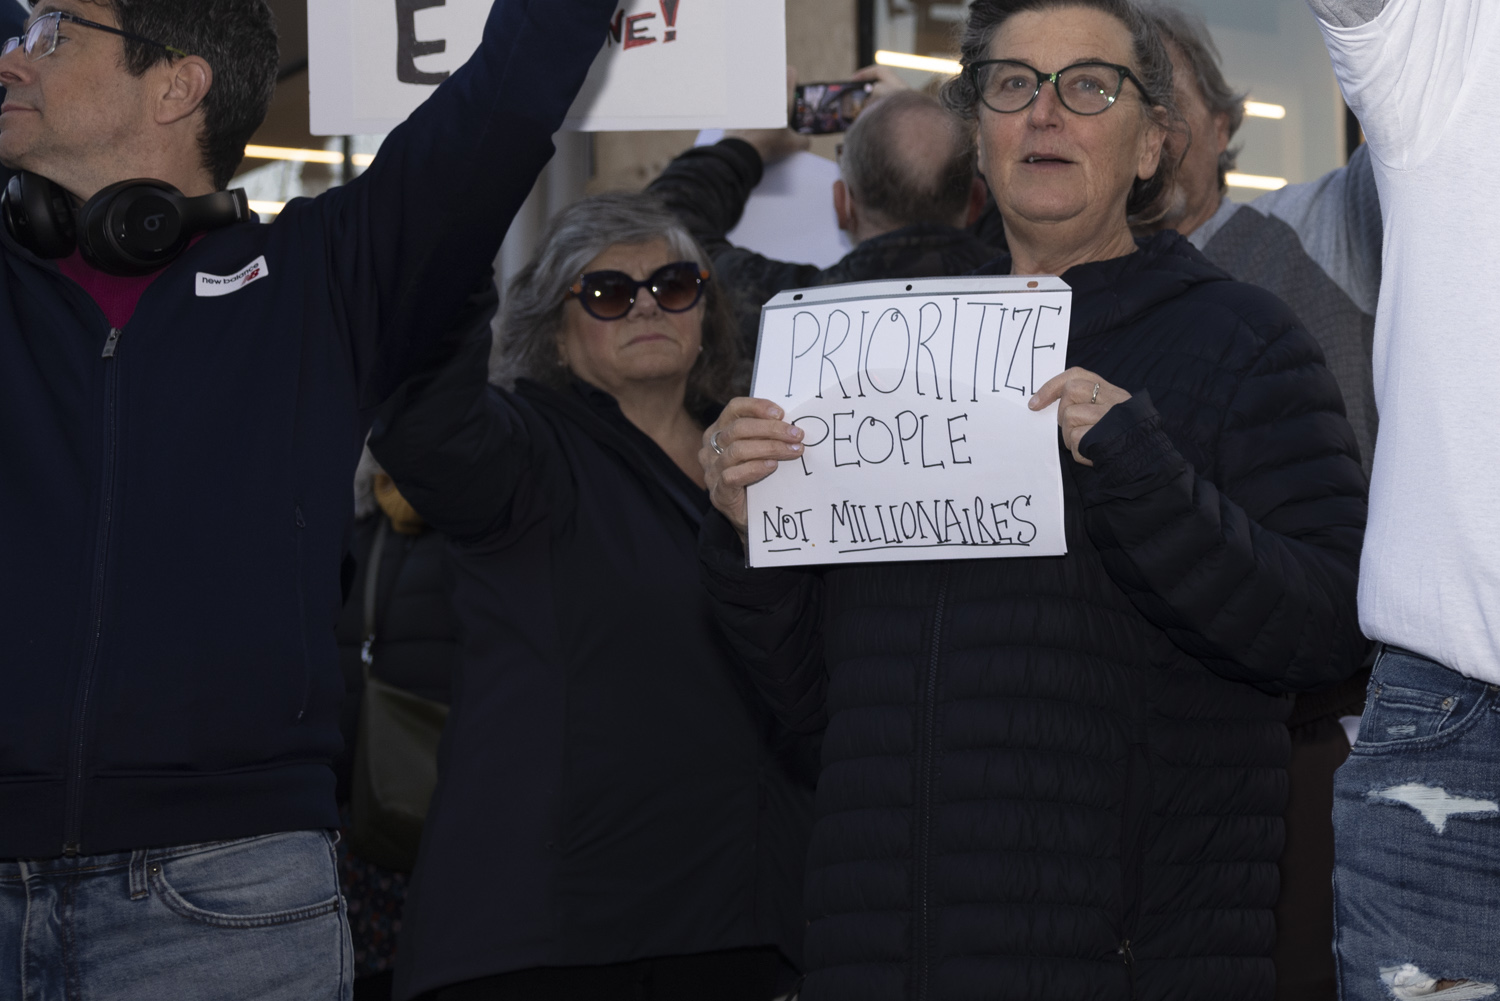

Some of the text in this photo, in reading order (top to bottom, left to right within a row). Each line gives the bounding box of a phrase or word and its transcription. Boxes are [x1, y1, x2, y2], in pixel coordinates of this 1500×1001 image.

[202, 262, 260, 286] new balance
[785, 297, 1062, 402] PRIORITIZE
[791, 410, 972, 476] PEOPLE
[763, 495, 1037, 546] NOT MILLIONAIRES
